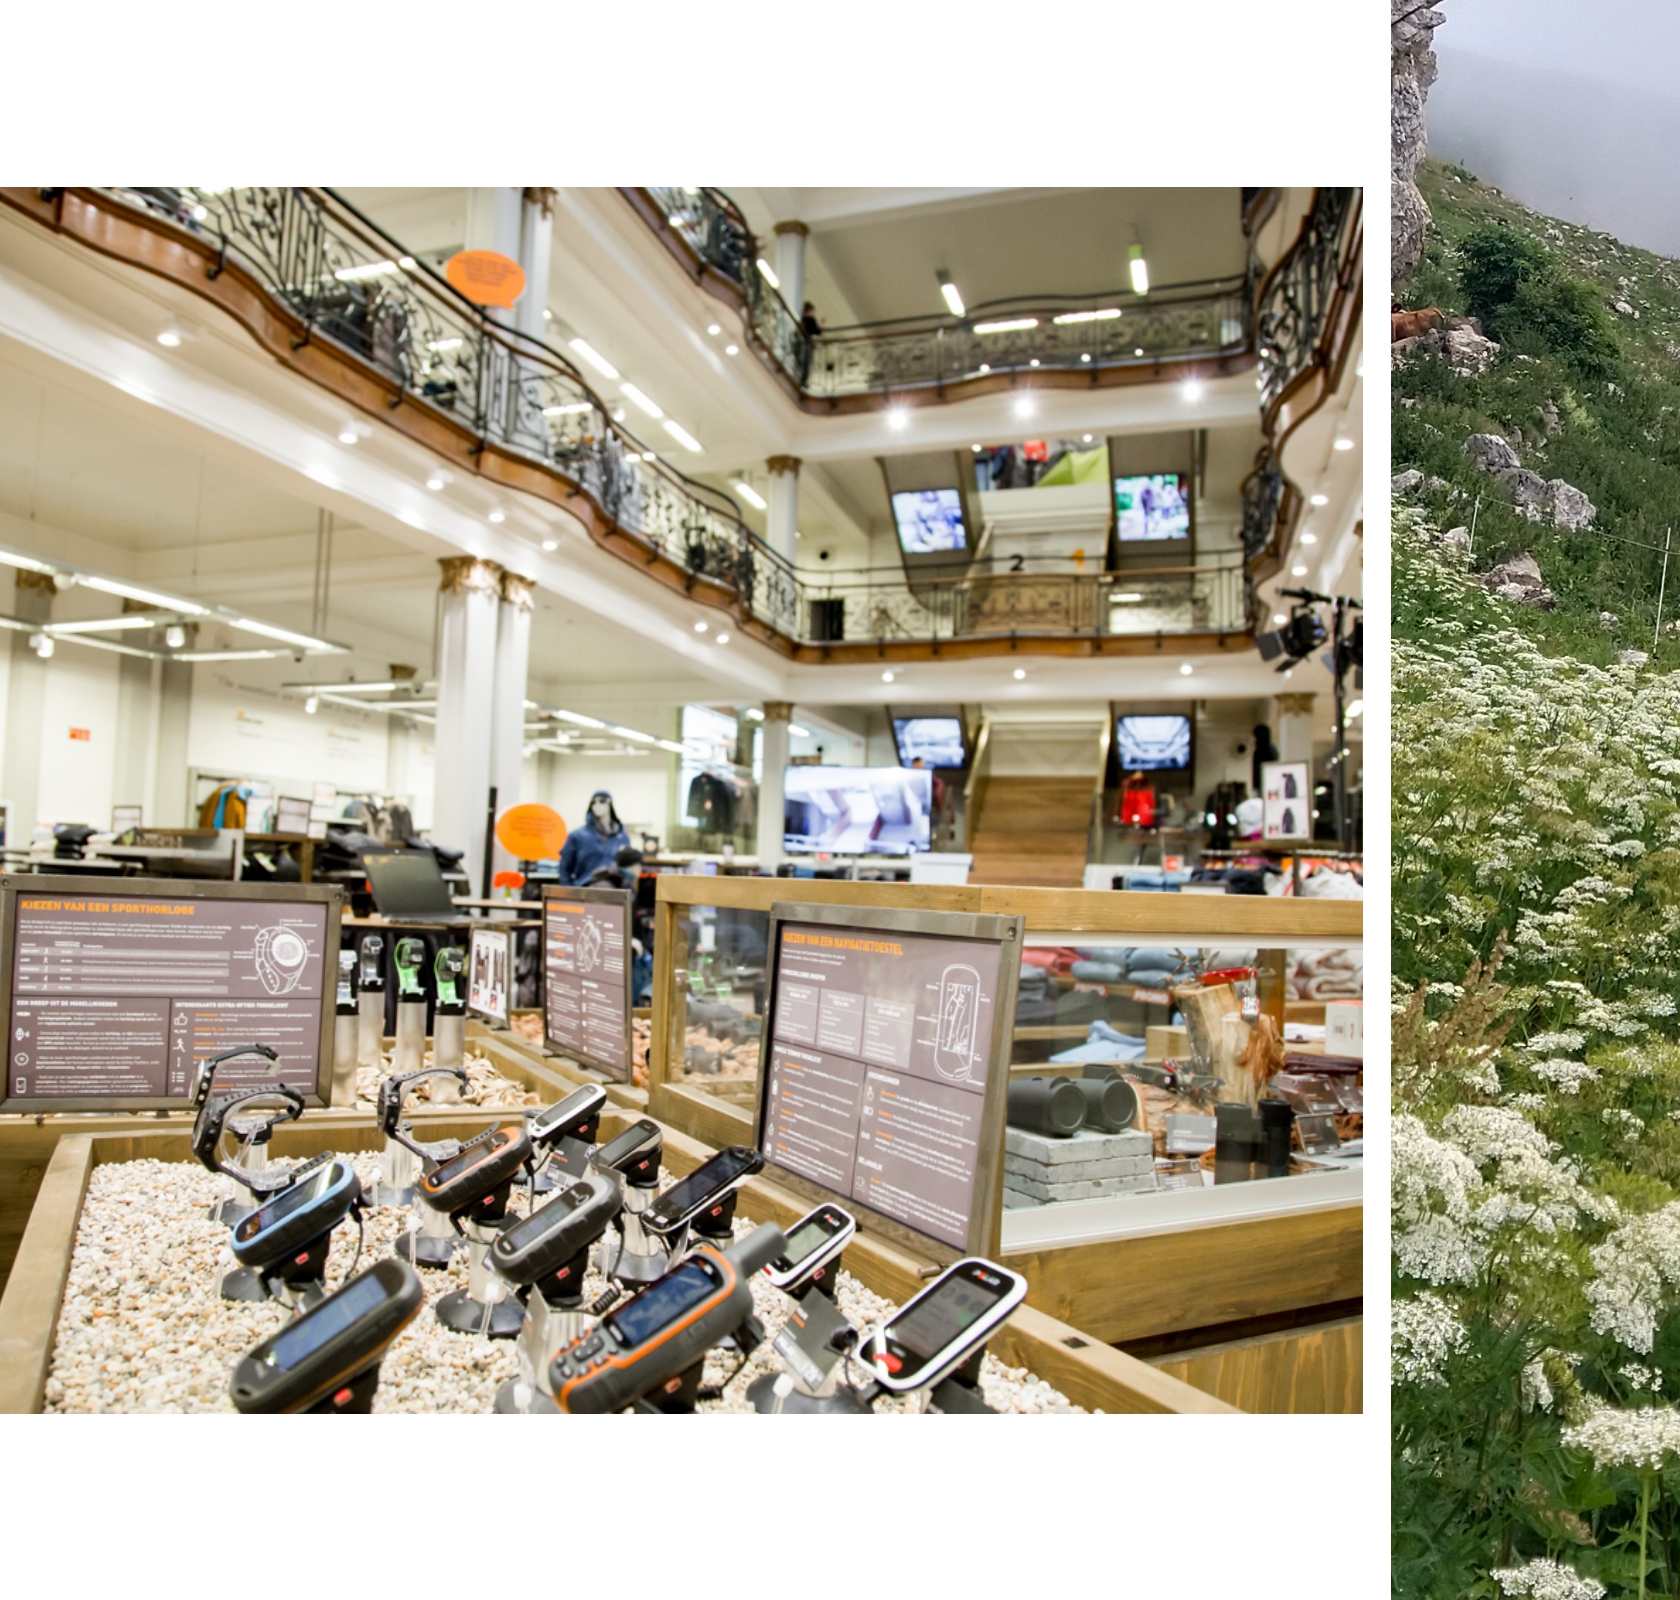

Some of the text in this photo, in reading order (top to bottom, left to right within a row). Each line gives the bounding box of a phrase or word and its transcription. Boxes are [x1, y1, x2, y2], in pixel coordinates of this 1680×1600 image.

[1010, 552, 1024, 571] 2
[20, 900, 195, 915] KIEZEN VAN EEN SPORTHORLOGE
[783, 931, 805, 944] KIEZEN
[807, 934, 819, 946] VAN
[820, 936, 833, 948] EEN
